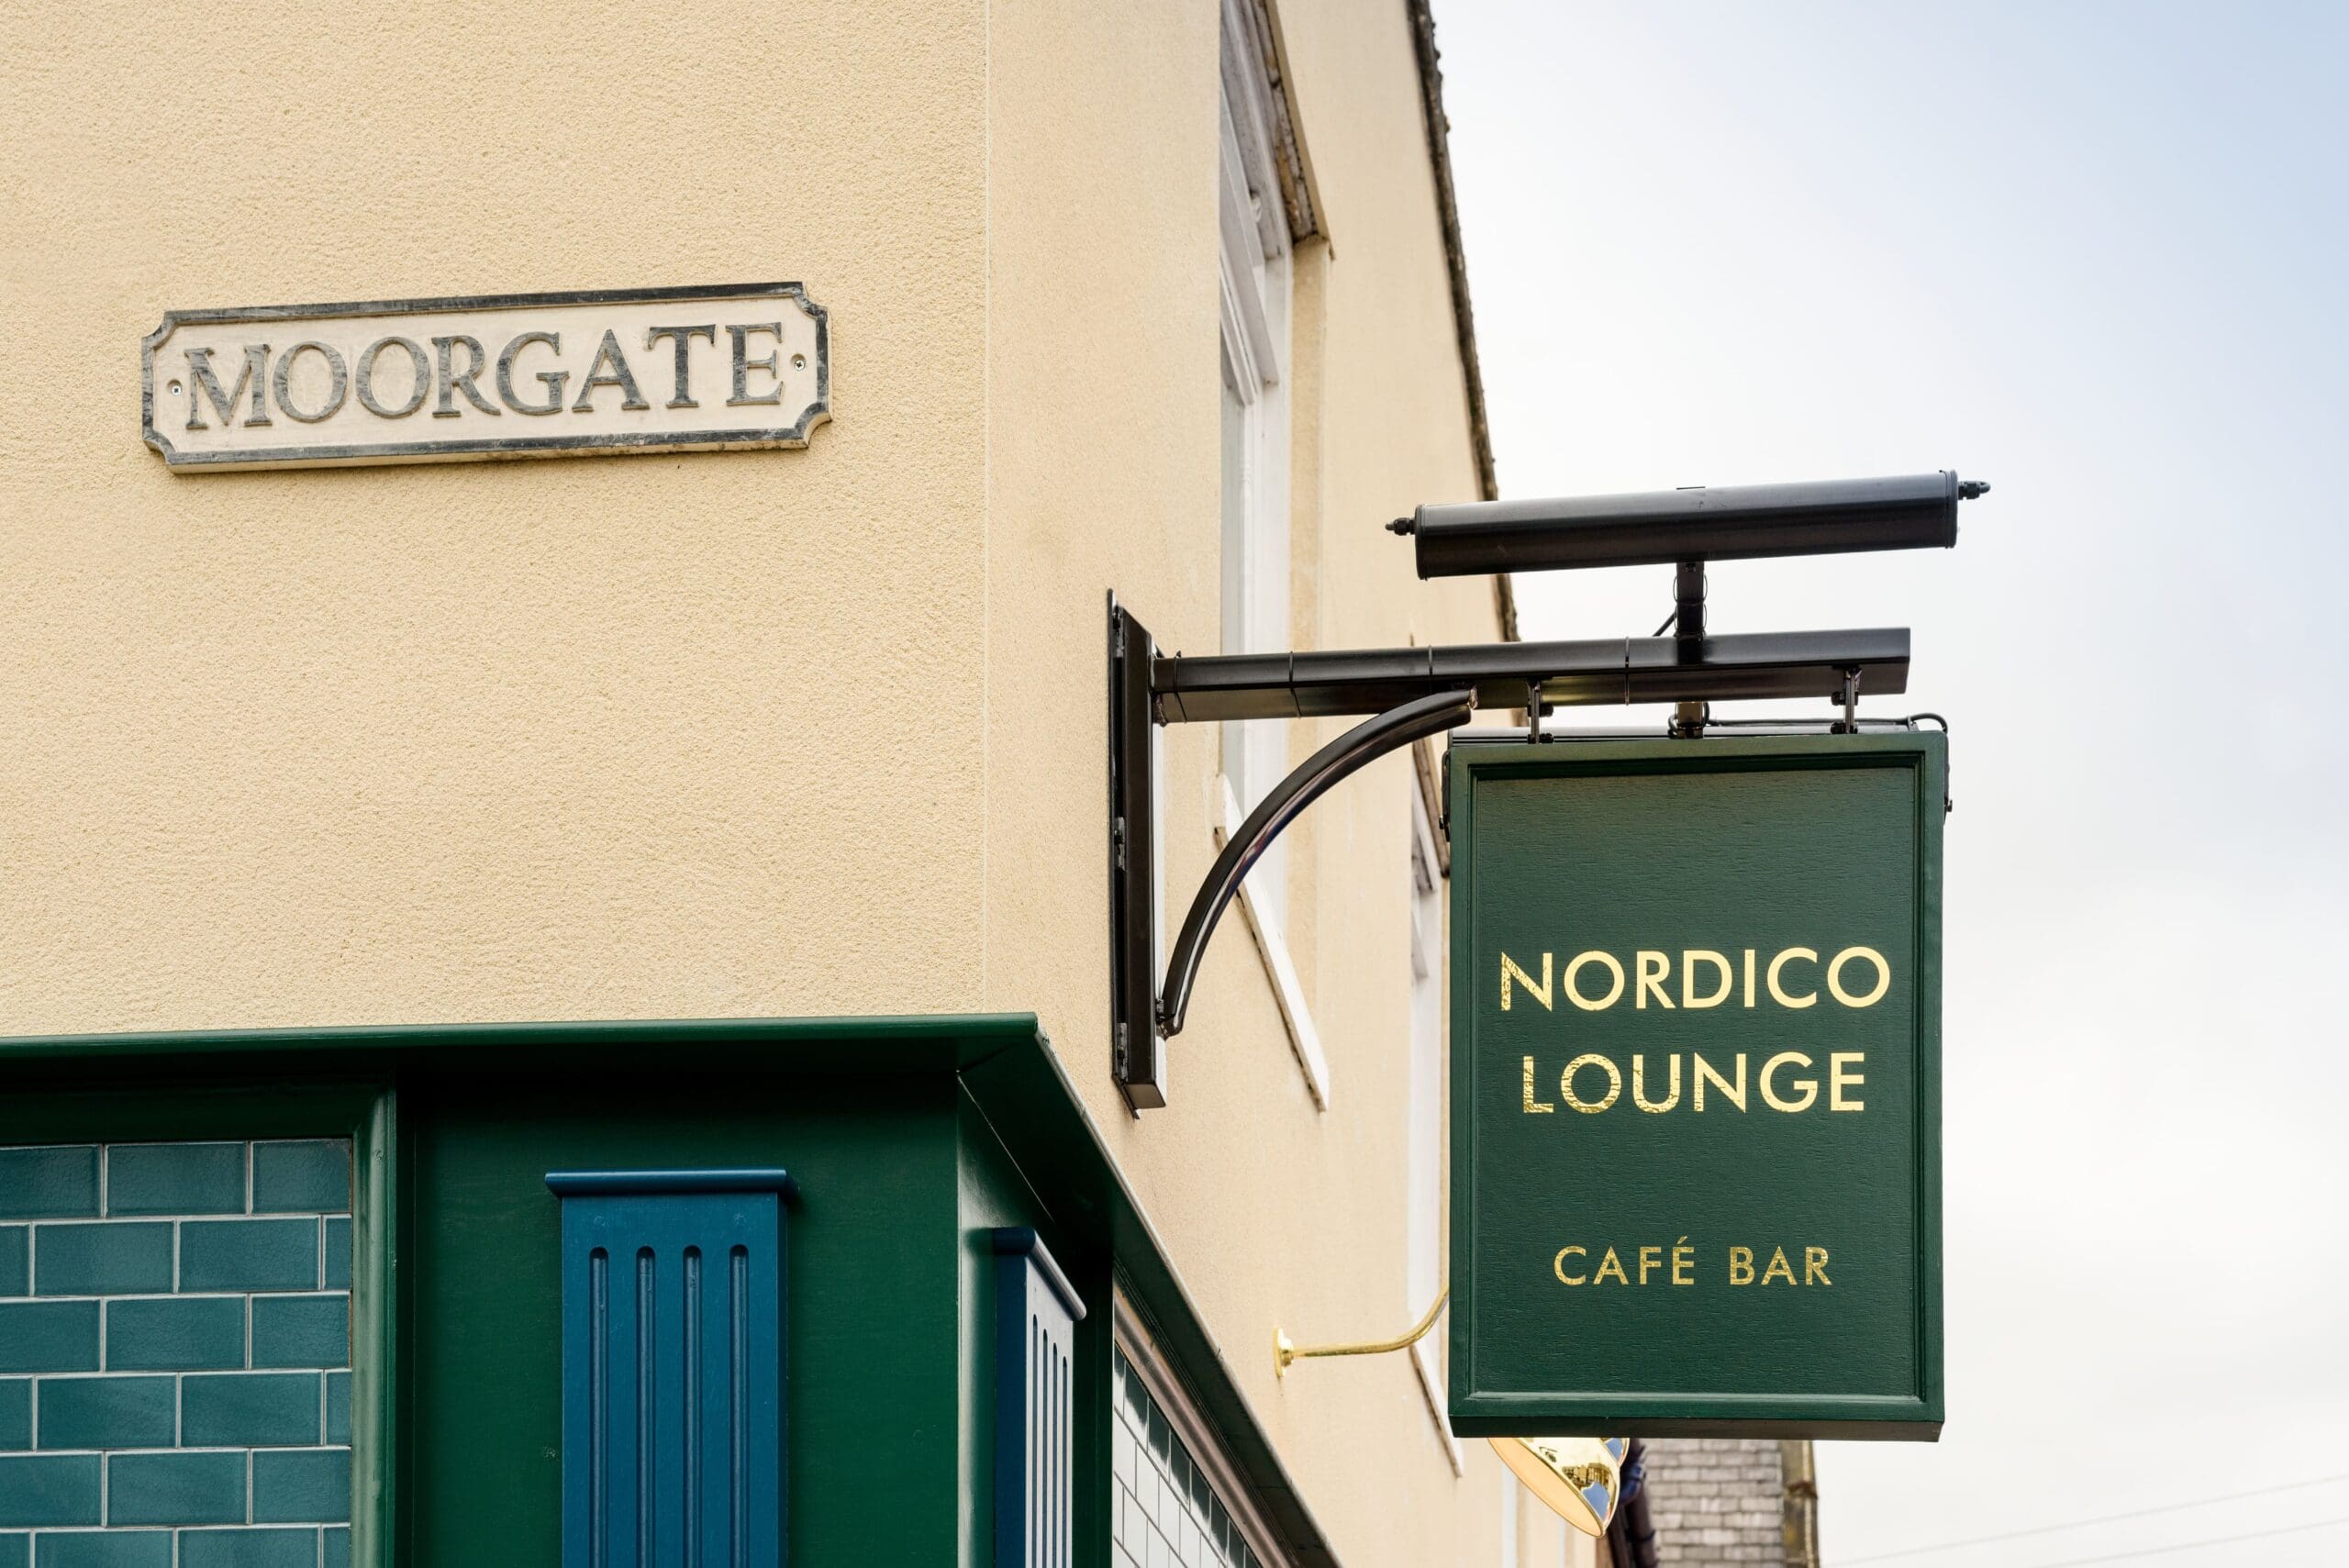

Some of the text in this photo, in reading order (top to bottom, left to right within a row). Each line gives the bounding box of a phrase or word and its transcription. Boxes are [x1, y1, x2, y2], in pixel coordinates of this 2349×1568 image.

[184, 321, 783, 429] MOORGATE
[1500, 947, 1891, 1012] NORDICO
[1521, 1051, 1865, 1114] LOUNGE
[1553, 1236, 1833, 1286] CAFÉ BAR
